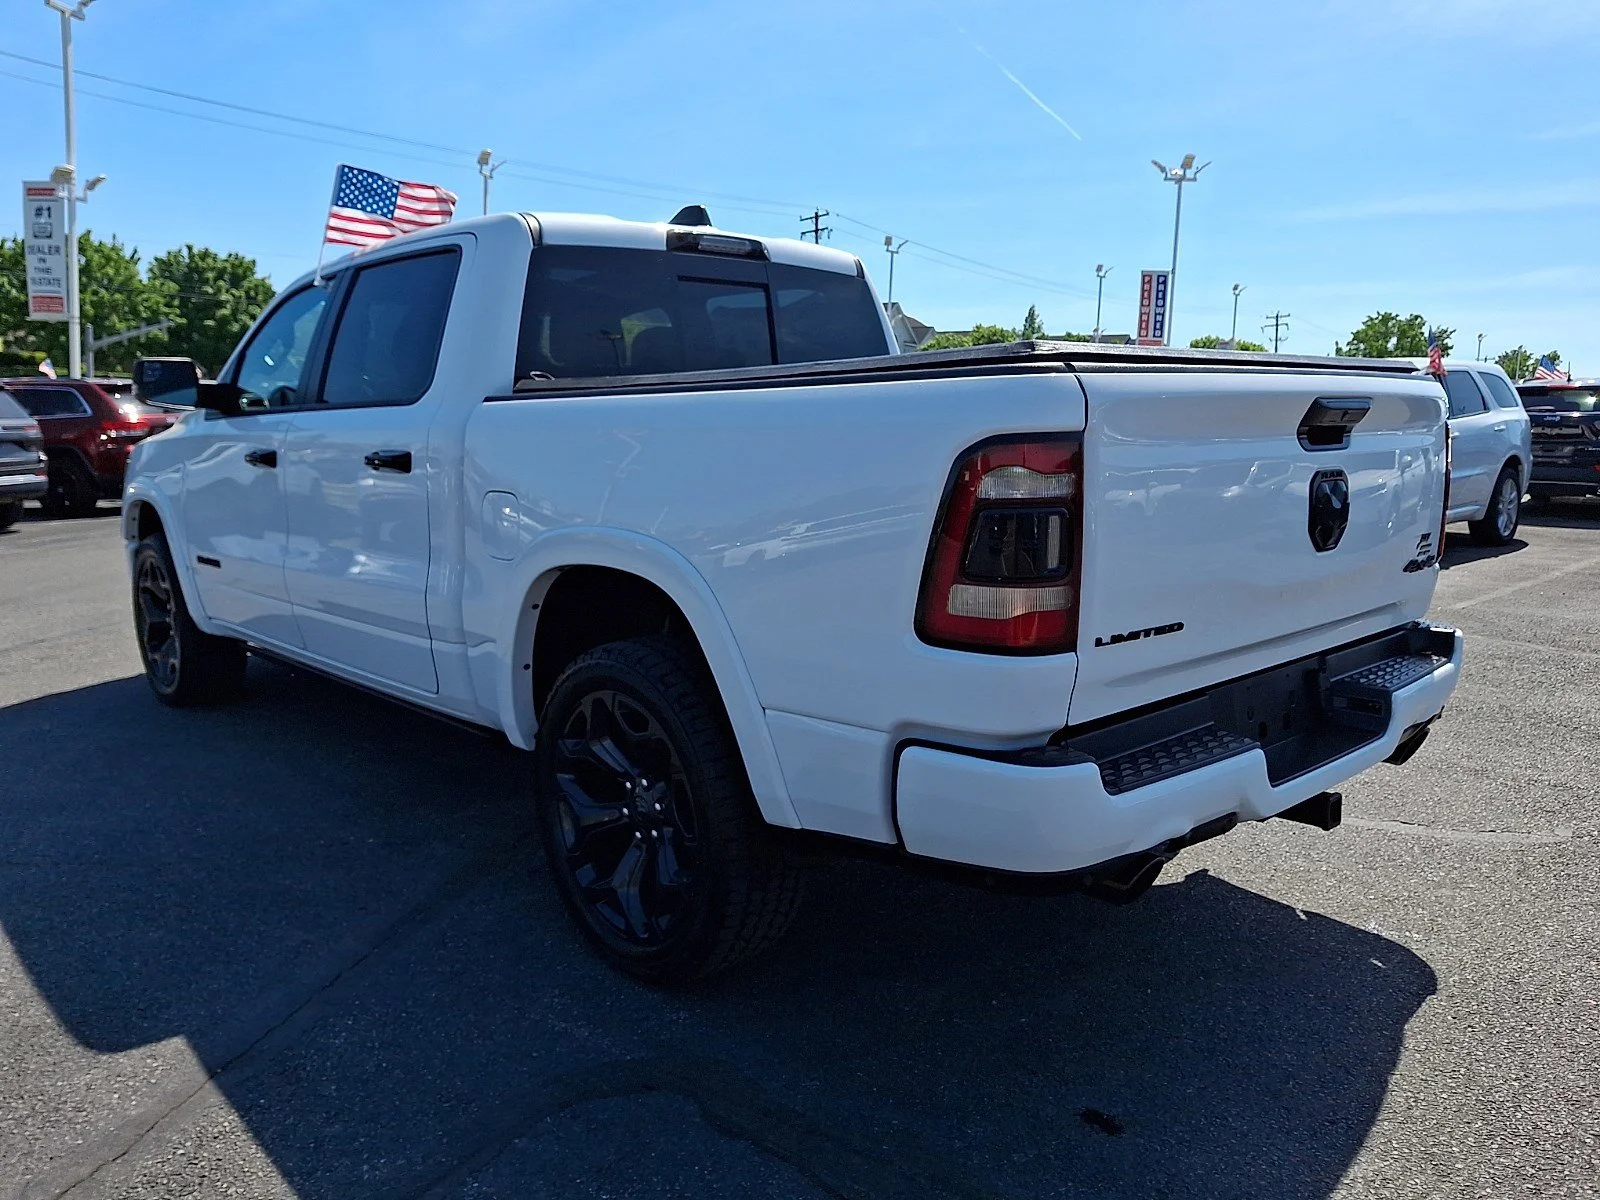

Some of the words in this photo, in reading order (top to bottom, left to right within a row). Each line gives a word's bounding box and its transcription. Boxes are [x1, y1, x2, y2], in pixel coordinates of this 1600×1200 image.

[34, 206, 51, 218] #1
[1319, 471, 1344, 480] RAM
[1094, 621, 1185, 648] LIMITED
